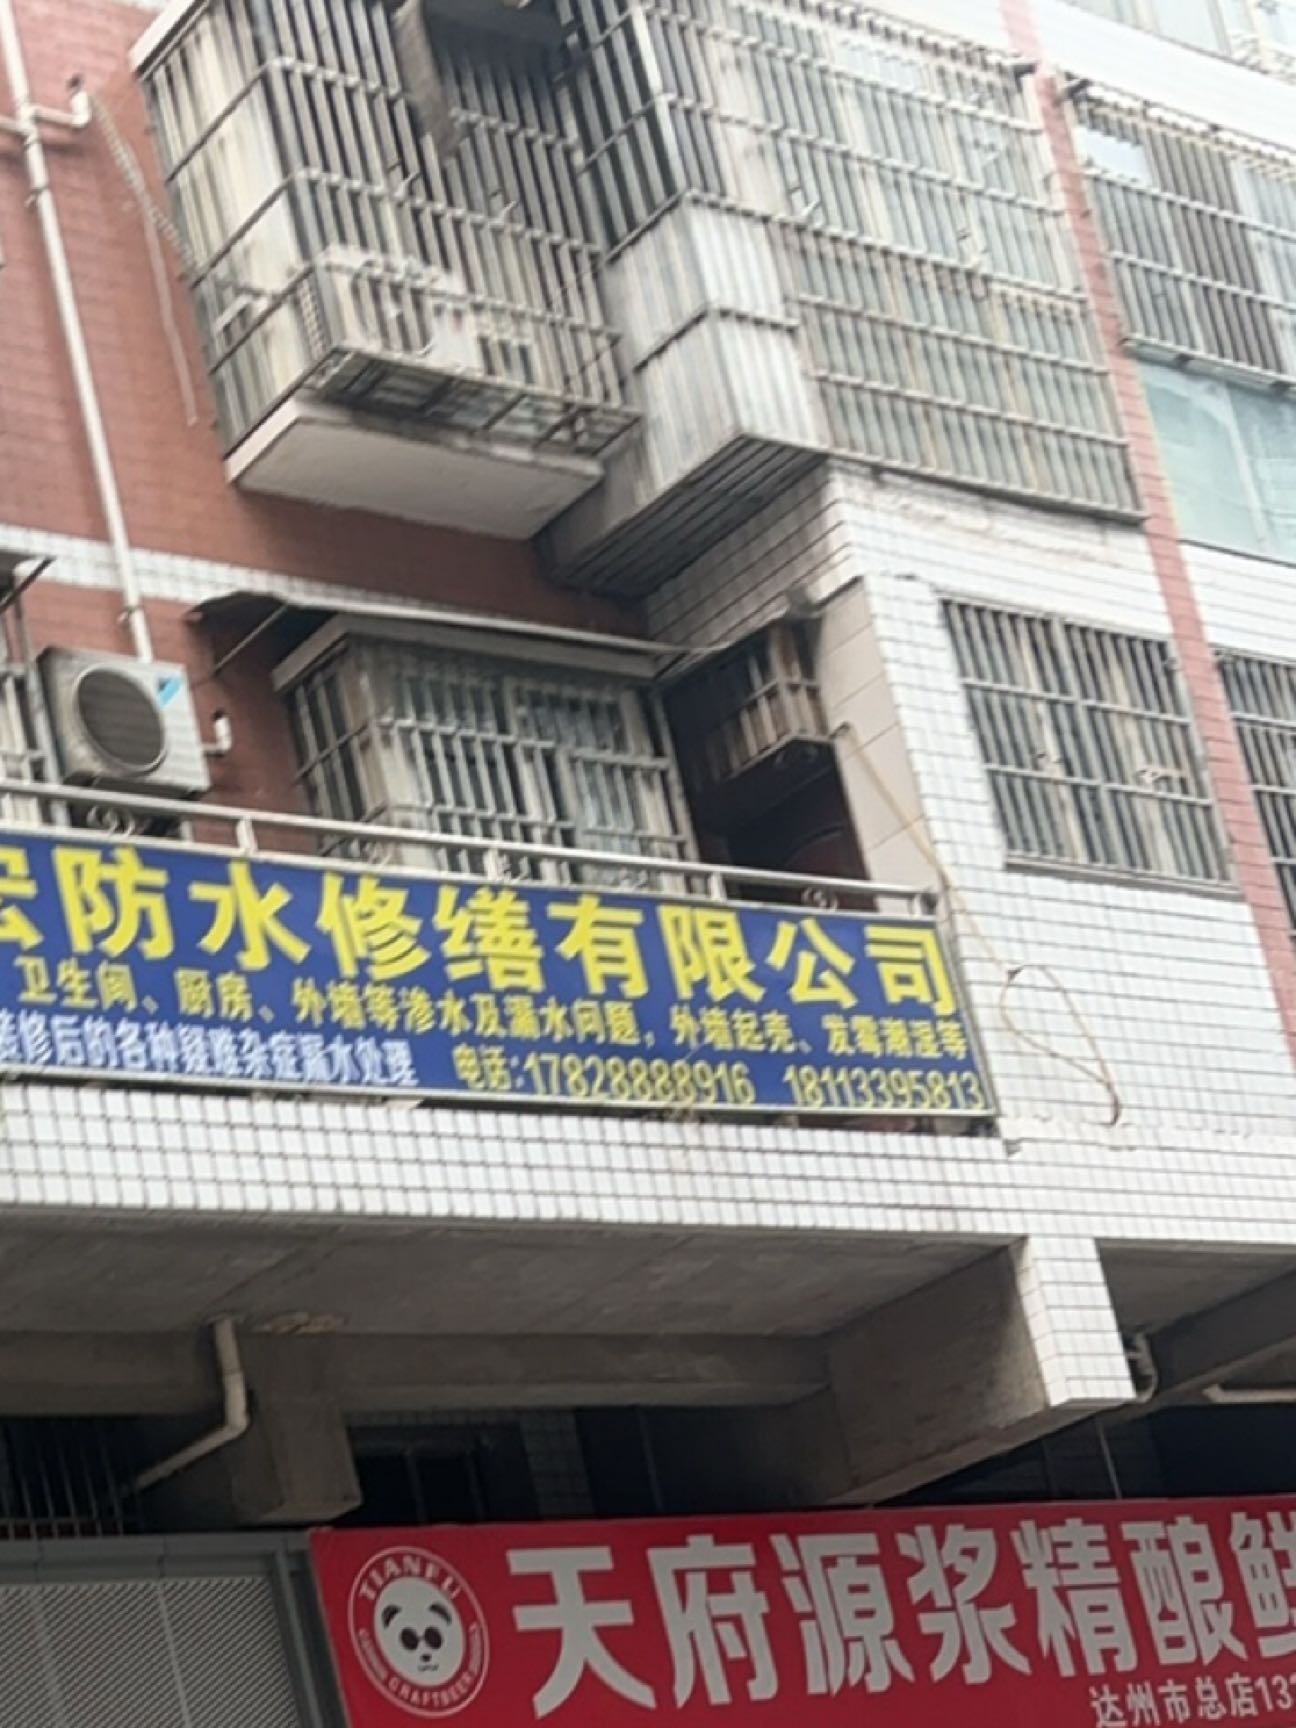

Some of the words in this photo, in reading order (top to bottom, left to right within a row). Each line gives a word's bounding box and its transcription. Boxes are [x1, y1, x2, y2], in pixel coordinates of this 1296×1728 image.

[783, 1064, 986, 1109] 18113395813
[505, 1511, 1296, 1721] 天府源浆精酿鲜
